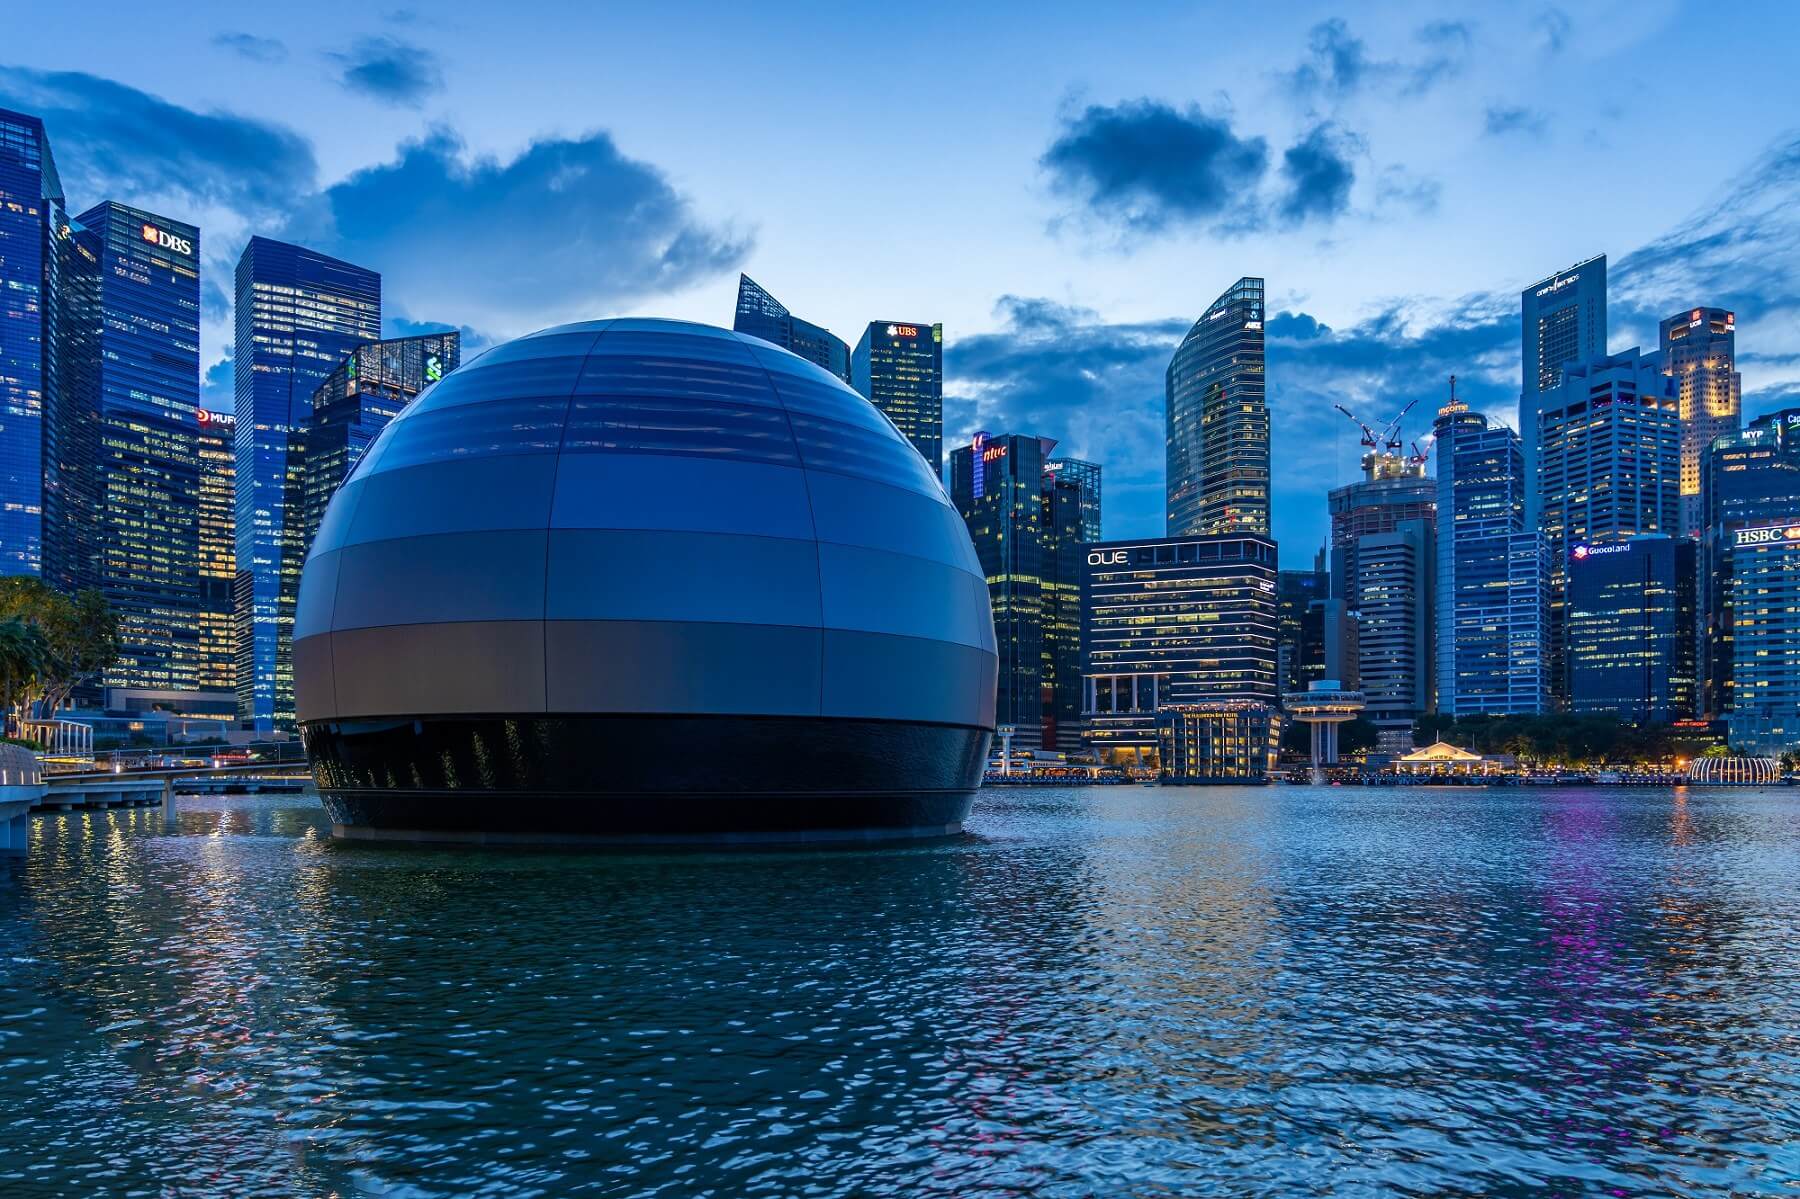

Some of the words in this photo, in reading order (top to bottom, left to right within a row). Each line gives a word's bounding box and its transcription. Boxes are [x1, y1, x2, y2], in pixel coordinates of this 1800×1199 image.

[159, 230, 191, 255] DBS
[898, 326, 917, 337] UBS
[1742, 430, 1763, 439] MYP
[983, 446, 1007, 462] ntuc
[1736, 528, 1782, 544] HSBC
[1588, 543, 1630, 555] GuocoLand
[1087, 551, 1128, 565] OUE
